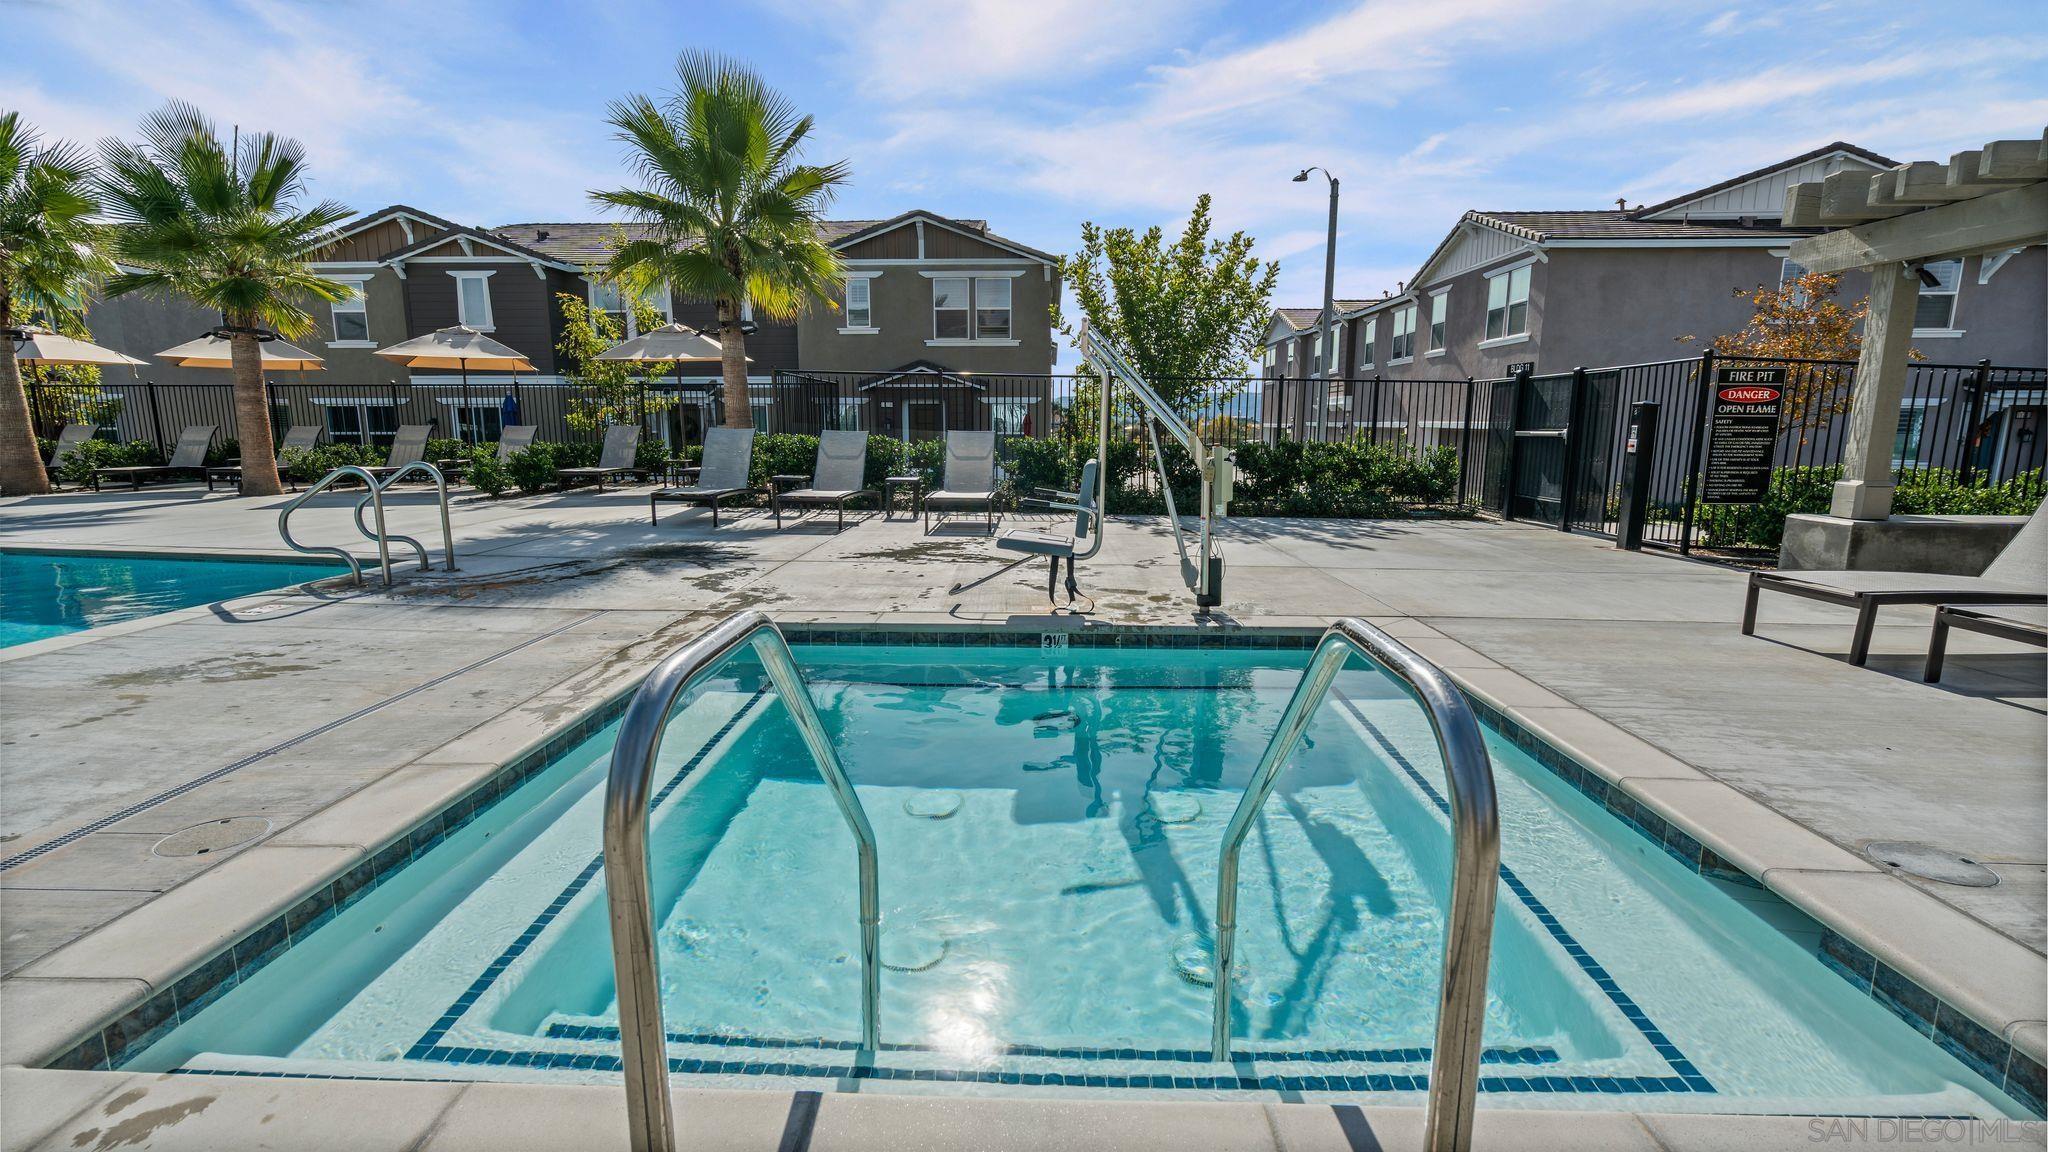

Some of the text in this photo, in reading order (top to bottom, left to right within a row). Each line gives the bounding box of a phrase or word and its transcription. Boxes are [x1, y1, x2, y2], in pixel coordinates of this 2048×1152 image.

[1729, 371, 1775, 382] FIRE PIT
[1728, 390, 1770, 399] DANGER
[1718, 405, 1777, 414] OPEN FLAME
